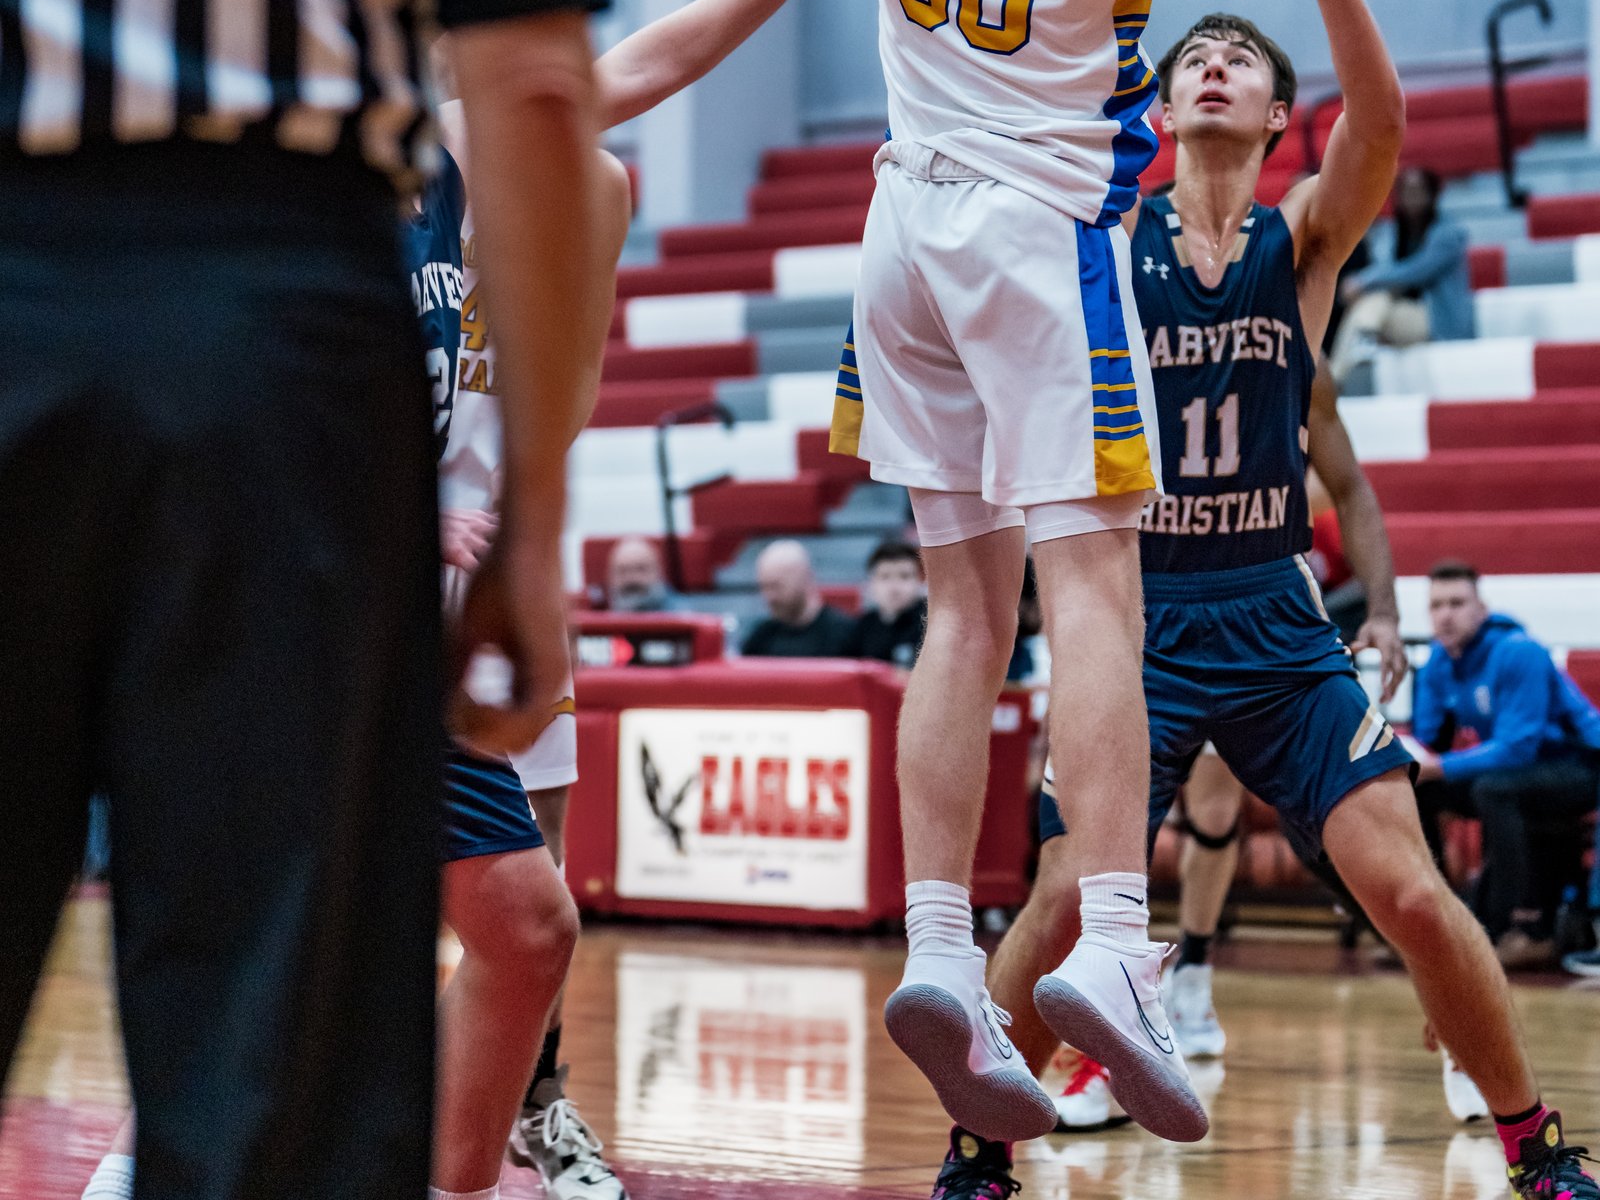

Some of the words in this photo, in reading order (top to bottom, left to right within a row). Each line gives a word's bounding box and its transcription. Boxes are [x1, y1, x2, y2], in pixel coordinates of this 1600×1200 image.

[1143, 317, 1292, 369] ARVEST
[1179, 393, 1241, 478] 11
[1137, 485, 1290, 536] HRISTIAN
[699, 755, 850, 840] EAGLES
